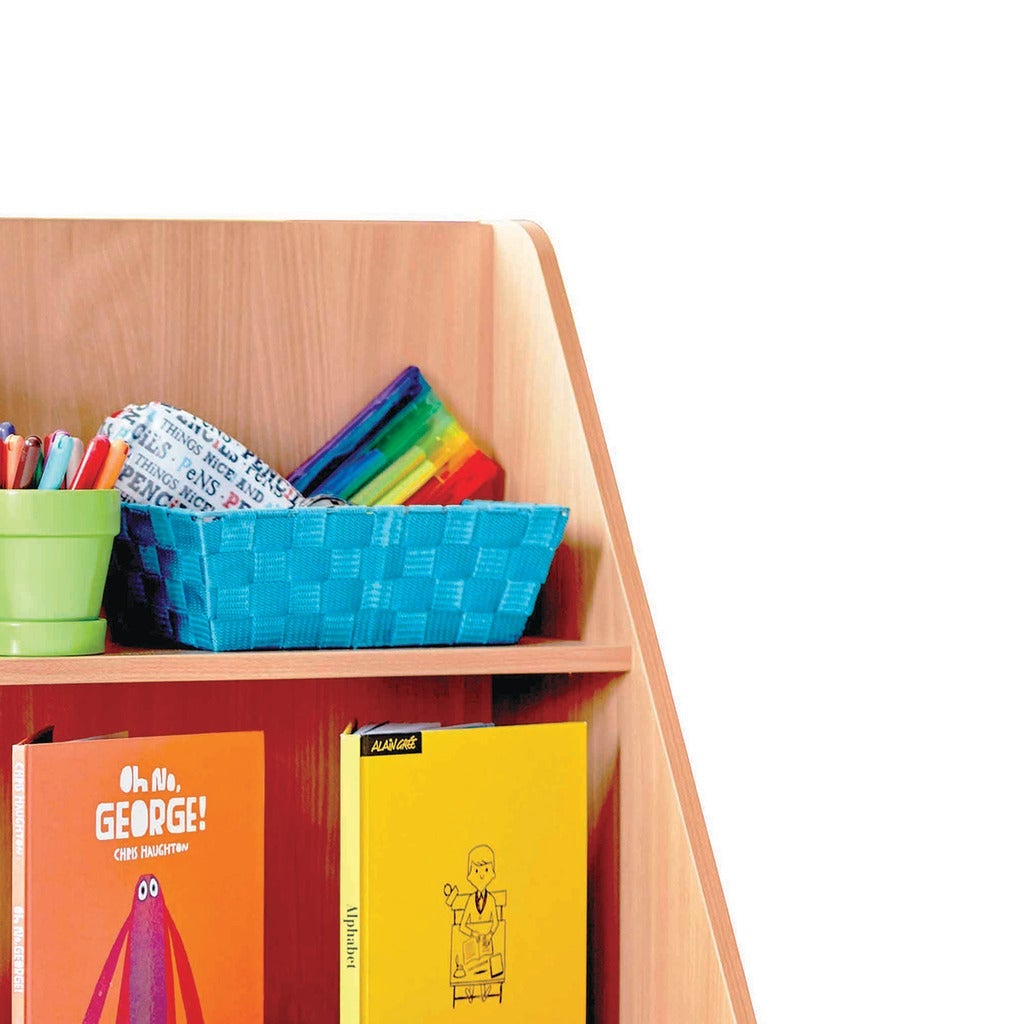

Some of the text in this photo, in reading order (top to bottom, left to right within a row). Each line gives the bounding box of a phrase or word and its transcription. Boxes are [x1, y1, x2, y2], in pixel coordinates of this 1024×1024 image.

[236, 478, 264, 503] AND
[120, 765, 181, 793] Oh No,
[95, 796, 207, 840] GEORGE!
[114, 843, 189, 861] CHRIS HAUGHTON
[343, 905, 358, 968] Alphabet
